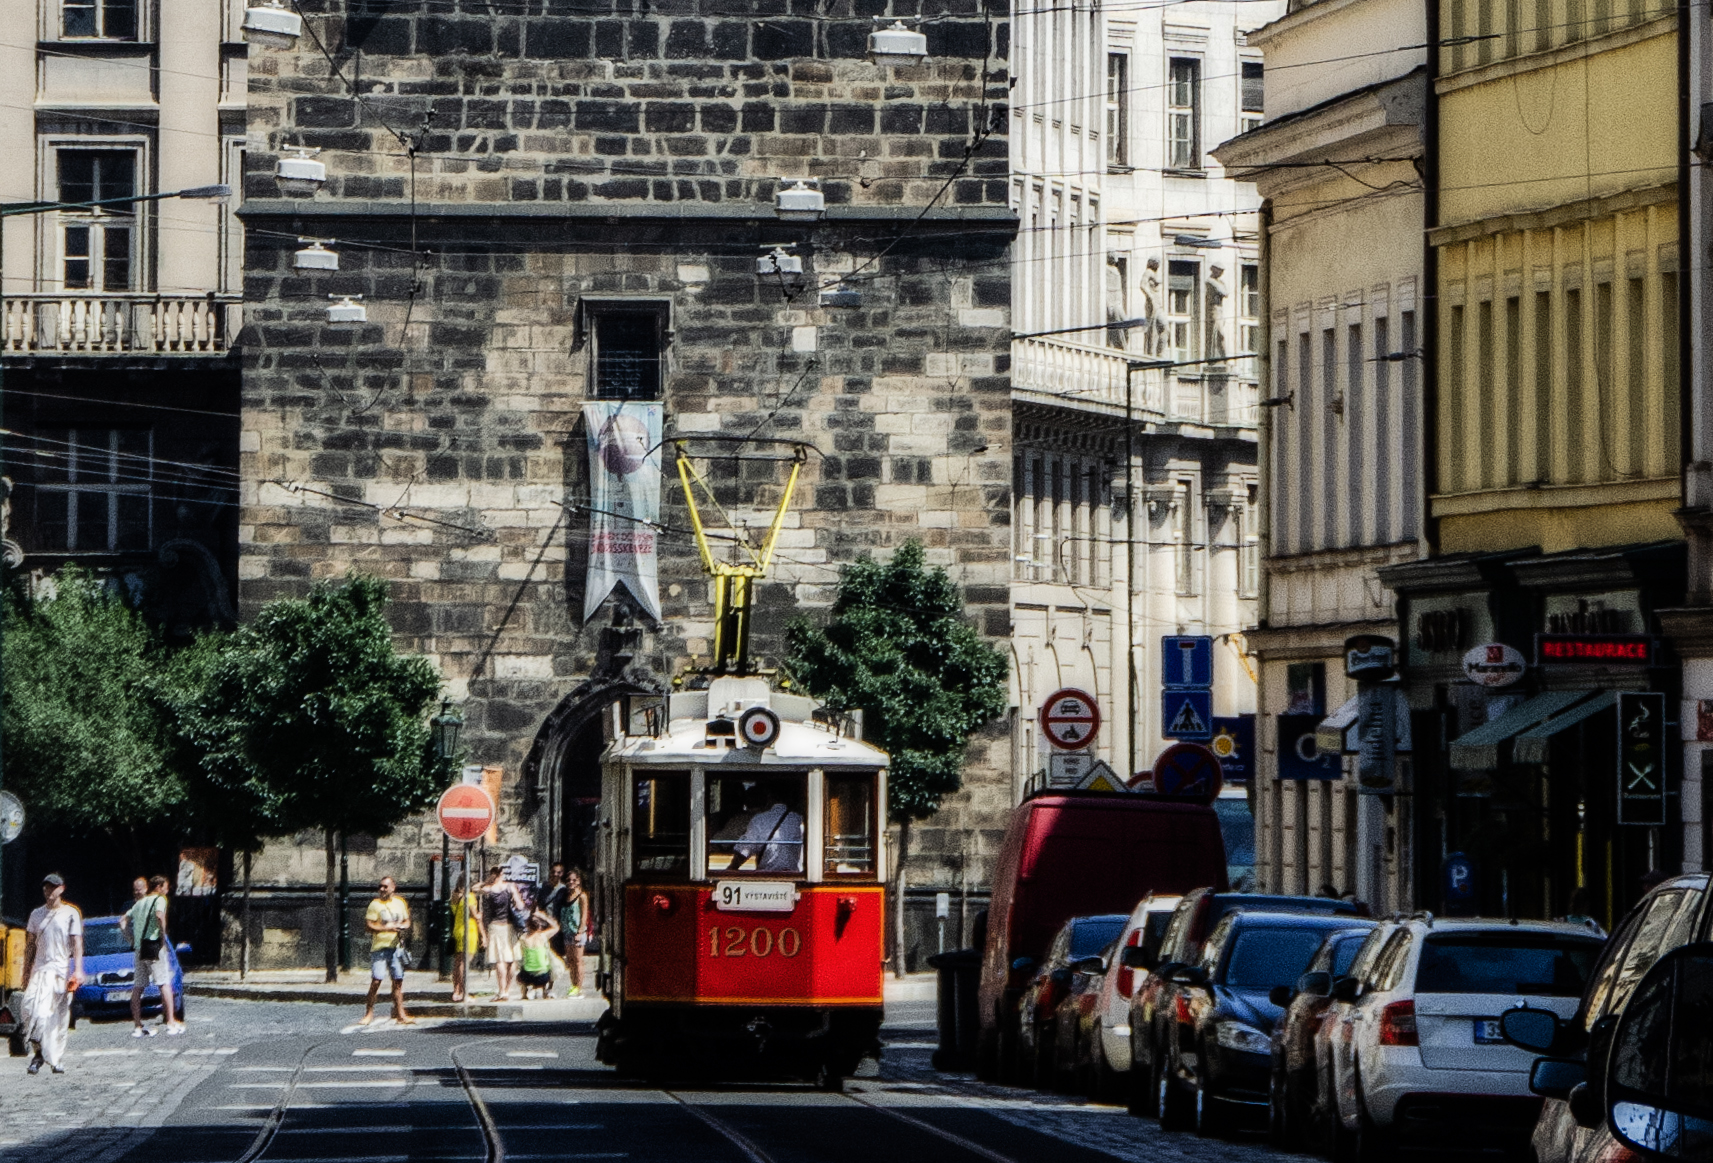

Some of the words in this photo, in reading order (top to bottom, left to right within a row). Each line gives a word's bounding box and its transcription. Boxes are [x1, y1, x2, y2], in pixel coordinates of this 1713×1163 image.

[1543, 641, 1646, 658] RESTAURACE
[1450, 865, 1467, 887] P
[723, 886, 741, 905] 91
[709, 926, 801, 957] 1200
